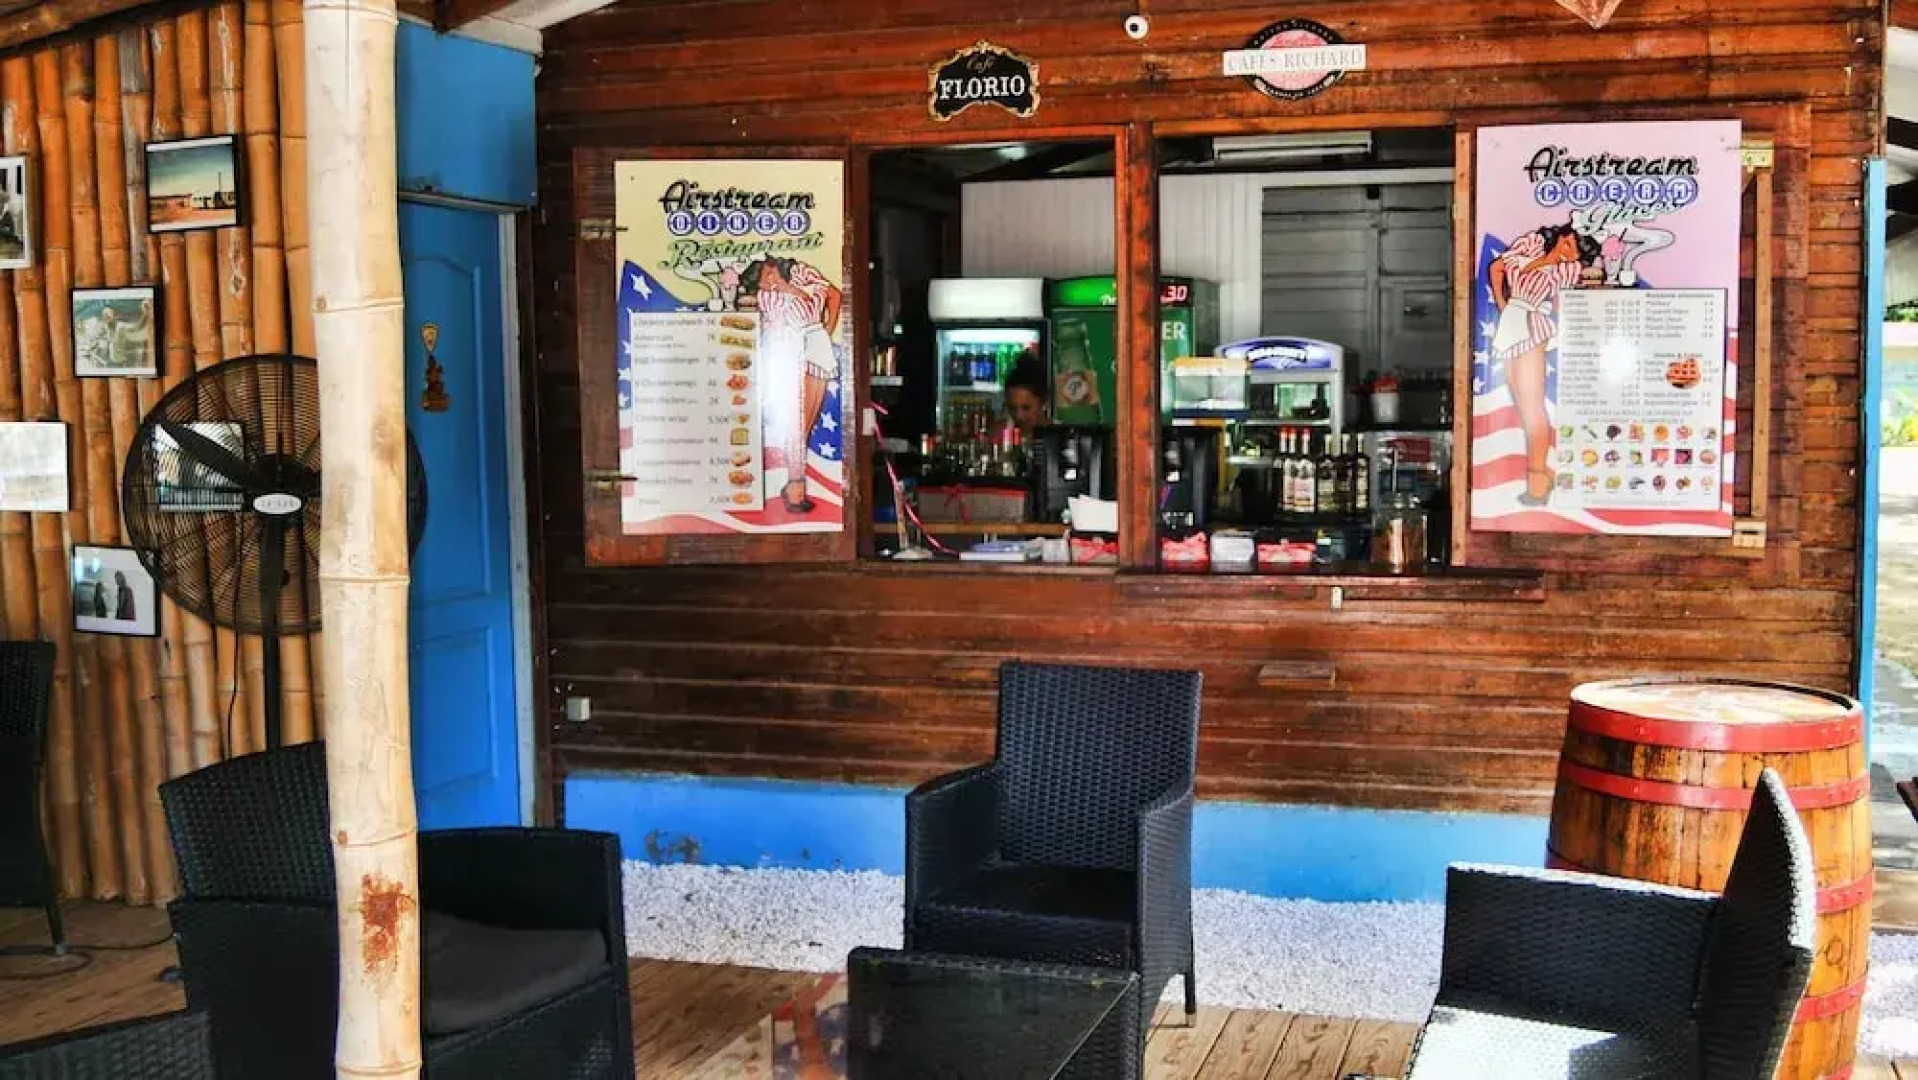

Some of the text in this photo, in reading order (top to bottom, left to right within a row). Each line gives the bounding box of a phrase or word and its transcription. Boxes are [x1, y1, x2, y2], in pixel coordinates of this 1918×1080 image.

[1284, 46, 1364, 68] RICHARD
[939, 74, 1026, 101] FLORIO
[1524, 145, 1700, 183] Airstream
[658, 179, 816, 214] Airstream
[1535, 177, 1699, 207] CREAM
[668, 209, 811, 236] DINER
